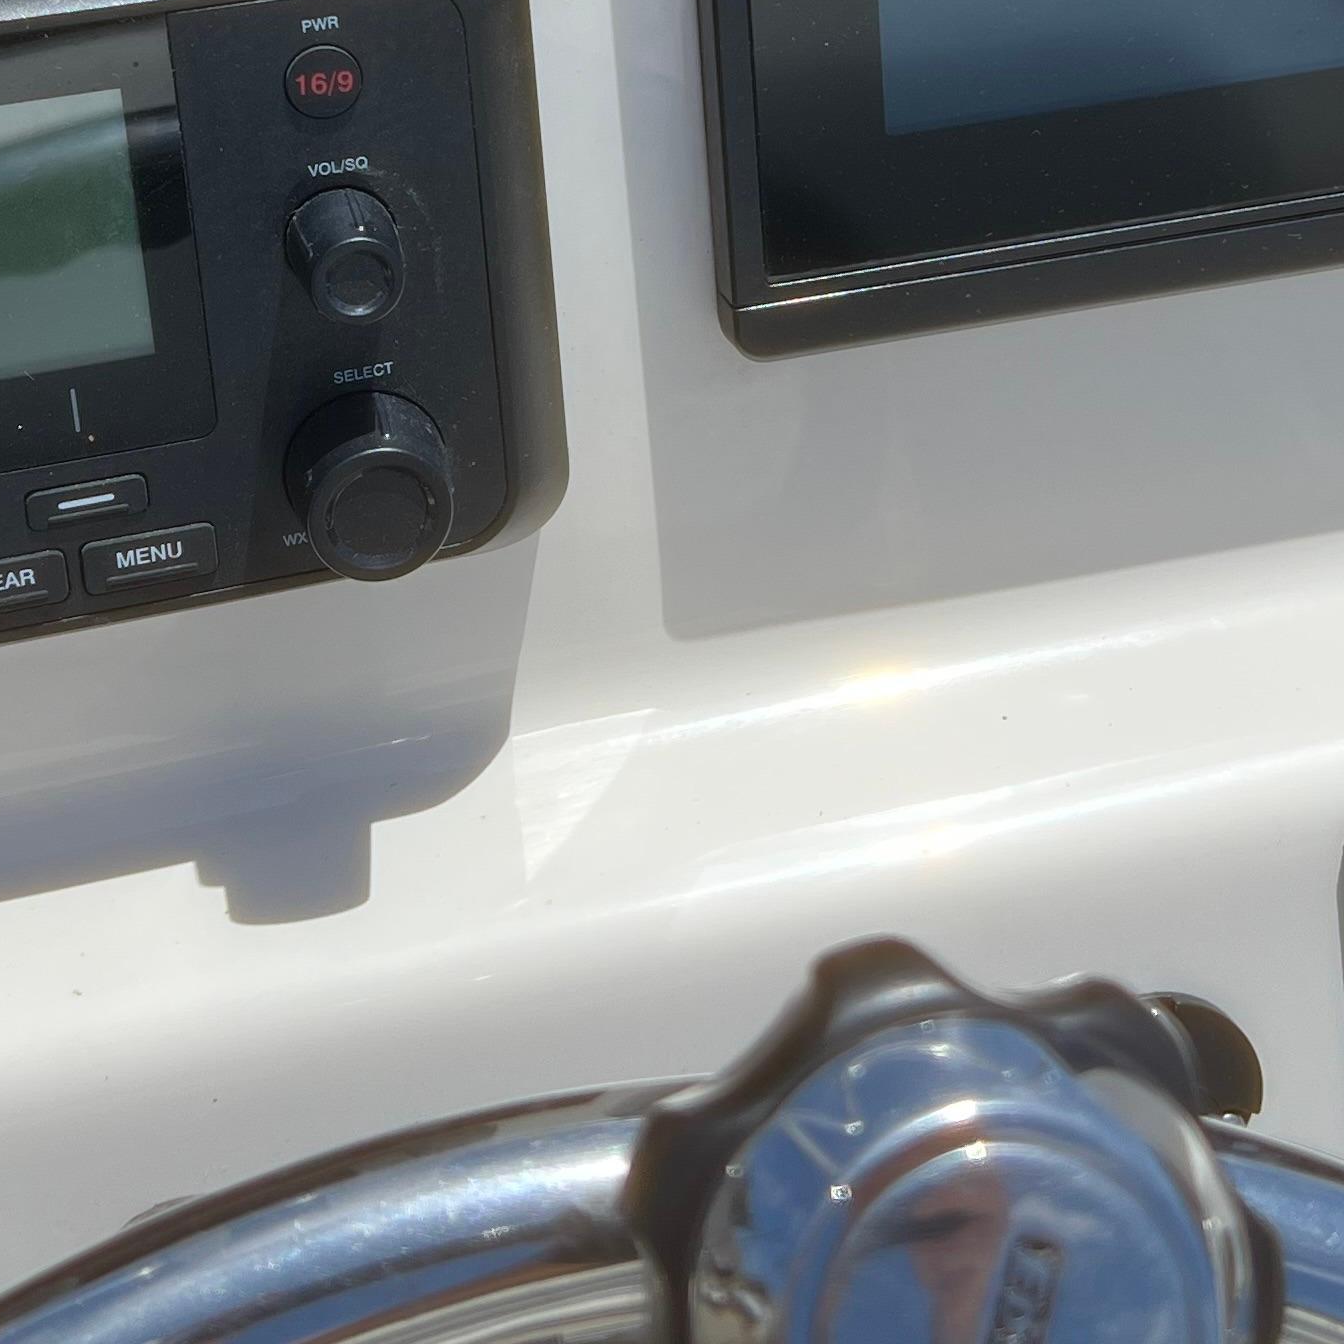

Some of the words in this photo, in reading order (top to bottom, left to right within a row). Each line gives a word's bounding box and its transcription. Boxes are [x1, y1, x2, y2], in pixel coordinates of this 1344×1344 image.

[301, 15, 340, 34] PWR
[295, 71, 353, 96] 16/9
[307, 156, 369, 177] VOL/SQ
[333, 361, 394, 384] SELECT
[282, 531, 308, 547] WX
[115, 540, 183, 569] MENU
